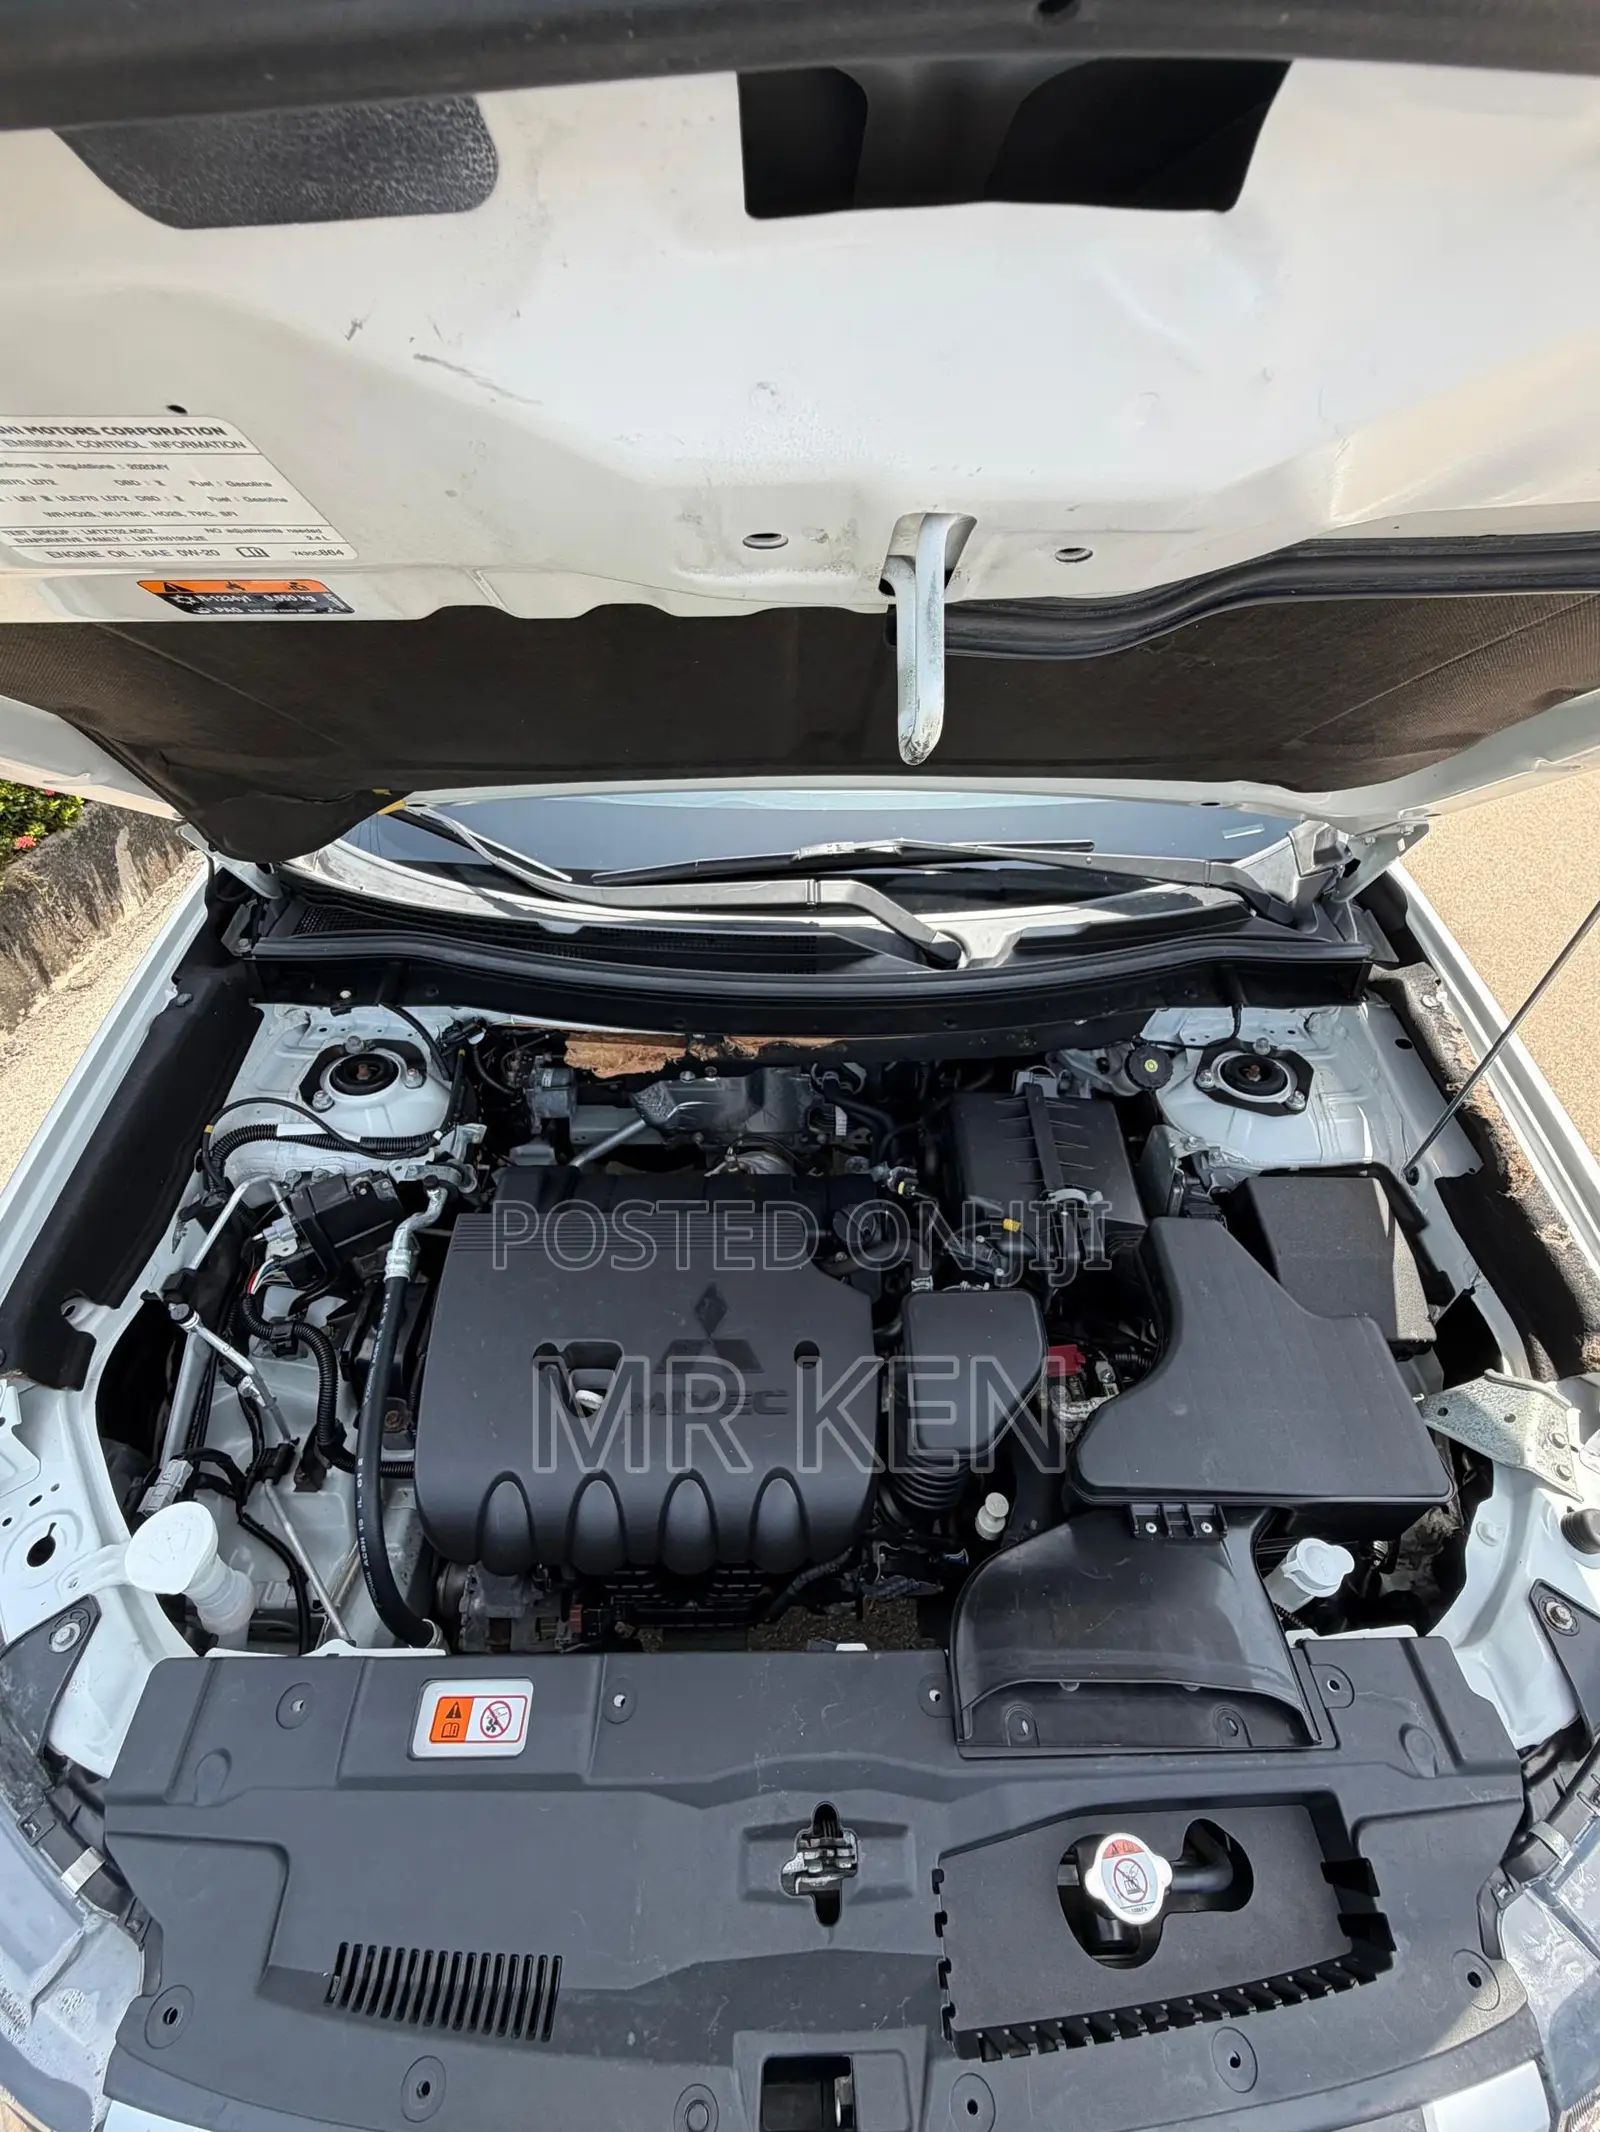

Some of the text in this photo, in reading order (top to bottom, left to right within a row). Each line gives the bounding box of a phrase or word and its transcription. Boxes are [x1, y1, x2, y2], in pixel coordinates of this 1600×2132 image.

[22, 426, 101, 435] MOTORS
[100, 426, 228, 436] CORPORATION
[4, 440, 247, 449] EMISSION CONTROL INFORMATION
[56, 463, 115, 471] regulations
[188, 480, 214, 488] Fuel
[225, 480, 273, 488] Gasoline
[45, 551, 107, 559] ENGINE
[107, 550, 137, 558] OIL
[140, 549, 175, 557] SAE
[175, 549, 221, 557] 0W-20
